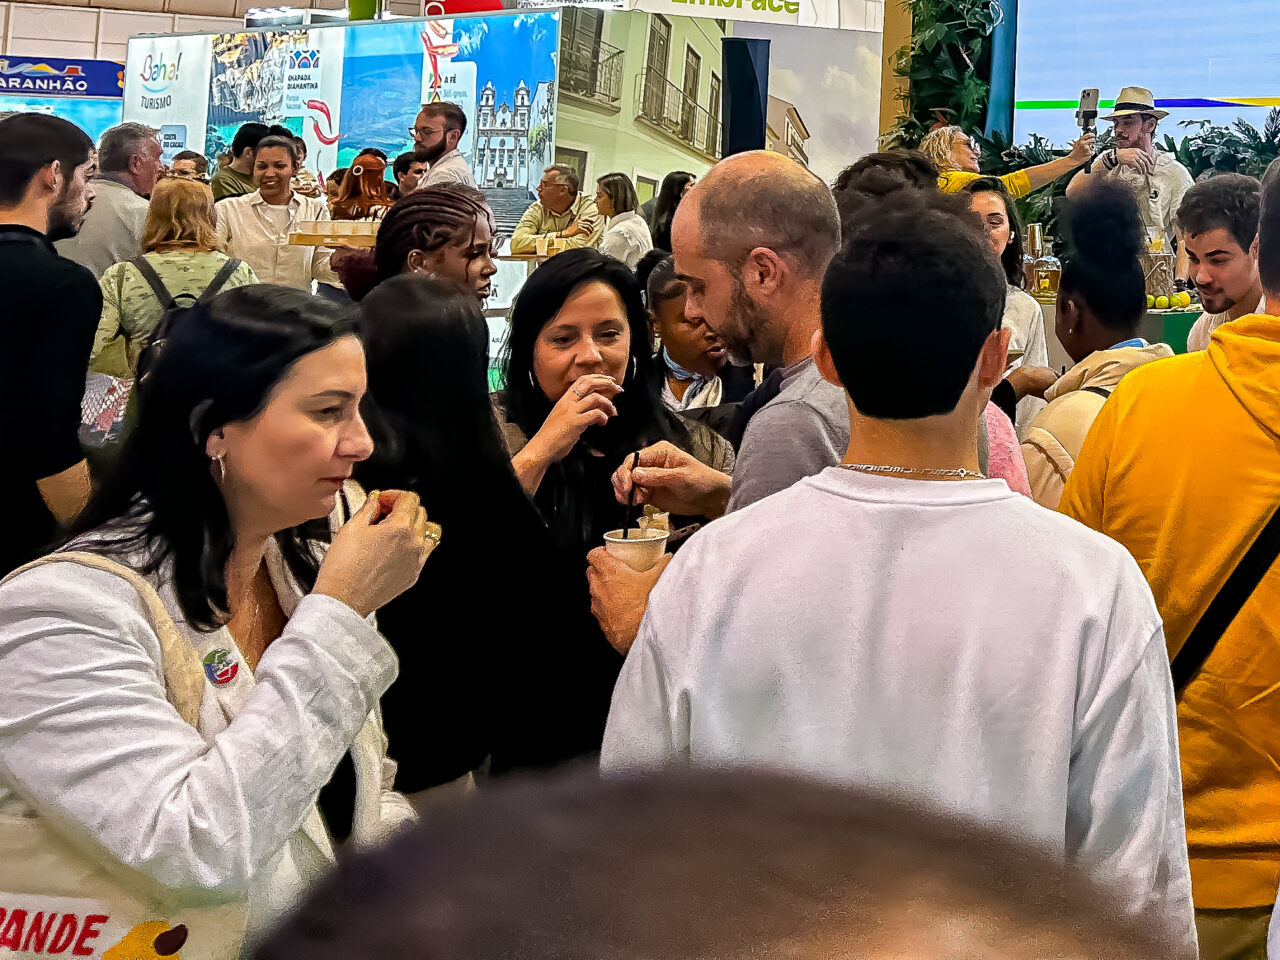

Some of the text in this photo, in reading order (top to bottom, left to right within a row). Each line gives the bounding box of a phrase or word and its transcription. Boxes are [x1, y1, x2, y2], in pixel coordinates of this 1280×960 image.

[140, 52, 182, 81] Baha!
[0, 77, 88, 91] ARANHÃO
[288, 74, 311, 82] CHAPADA
[287, 82, 318, 90] DIAMANTINA
[141, 95, 171, 109] TURISMO
[0, 907, 109, 956] ANDE
